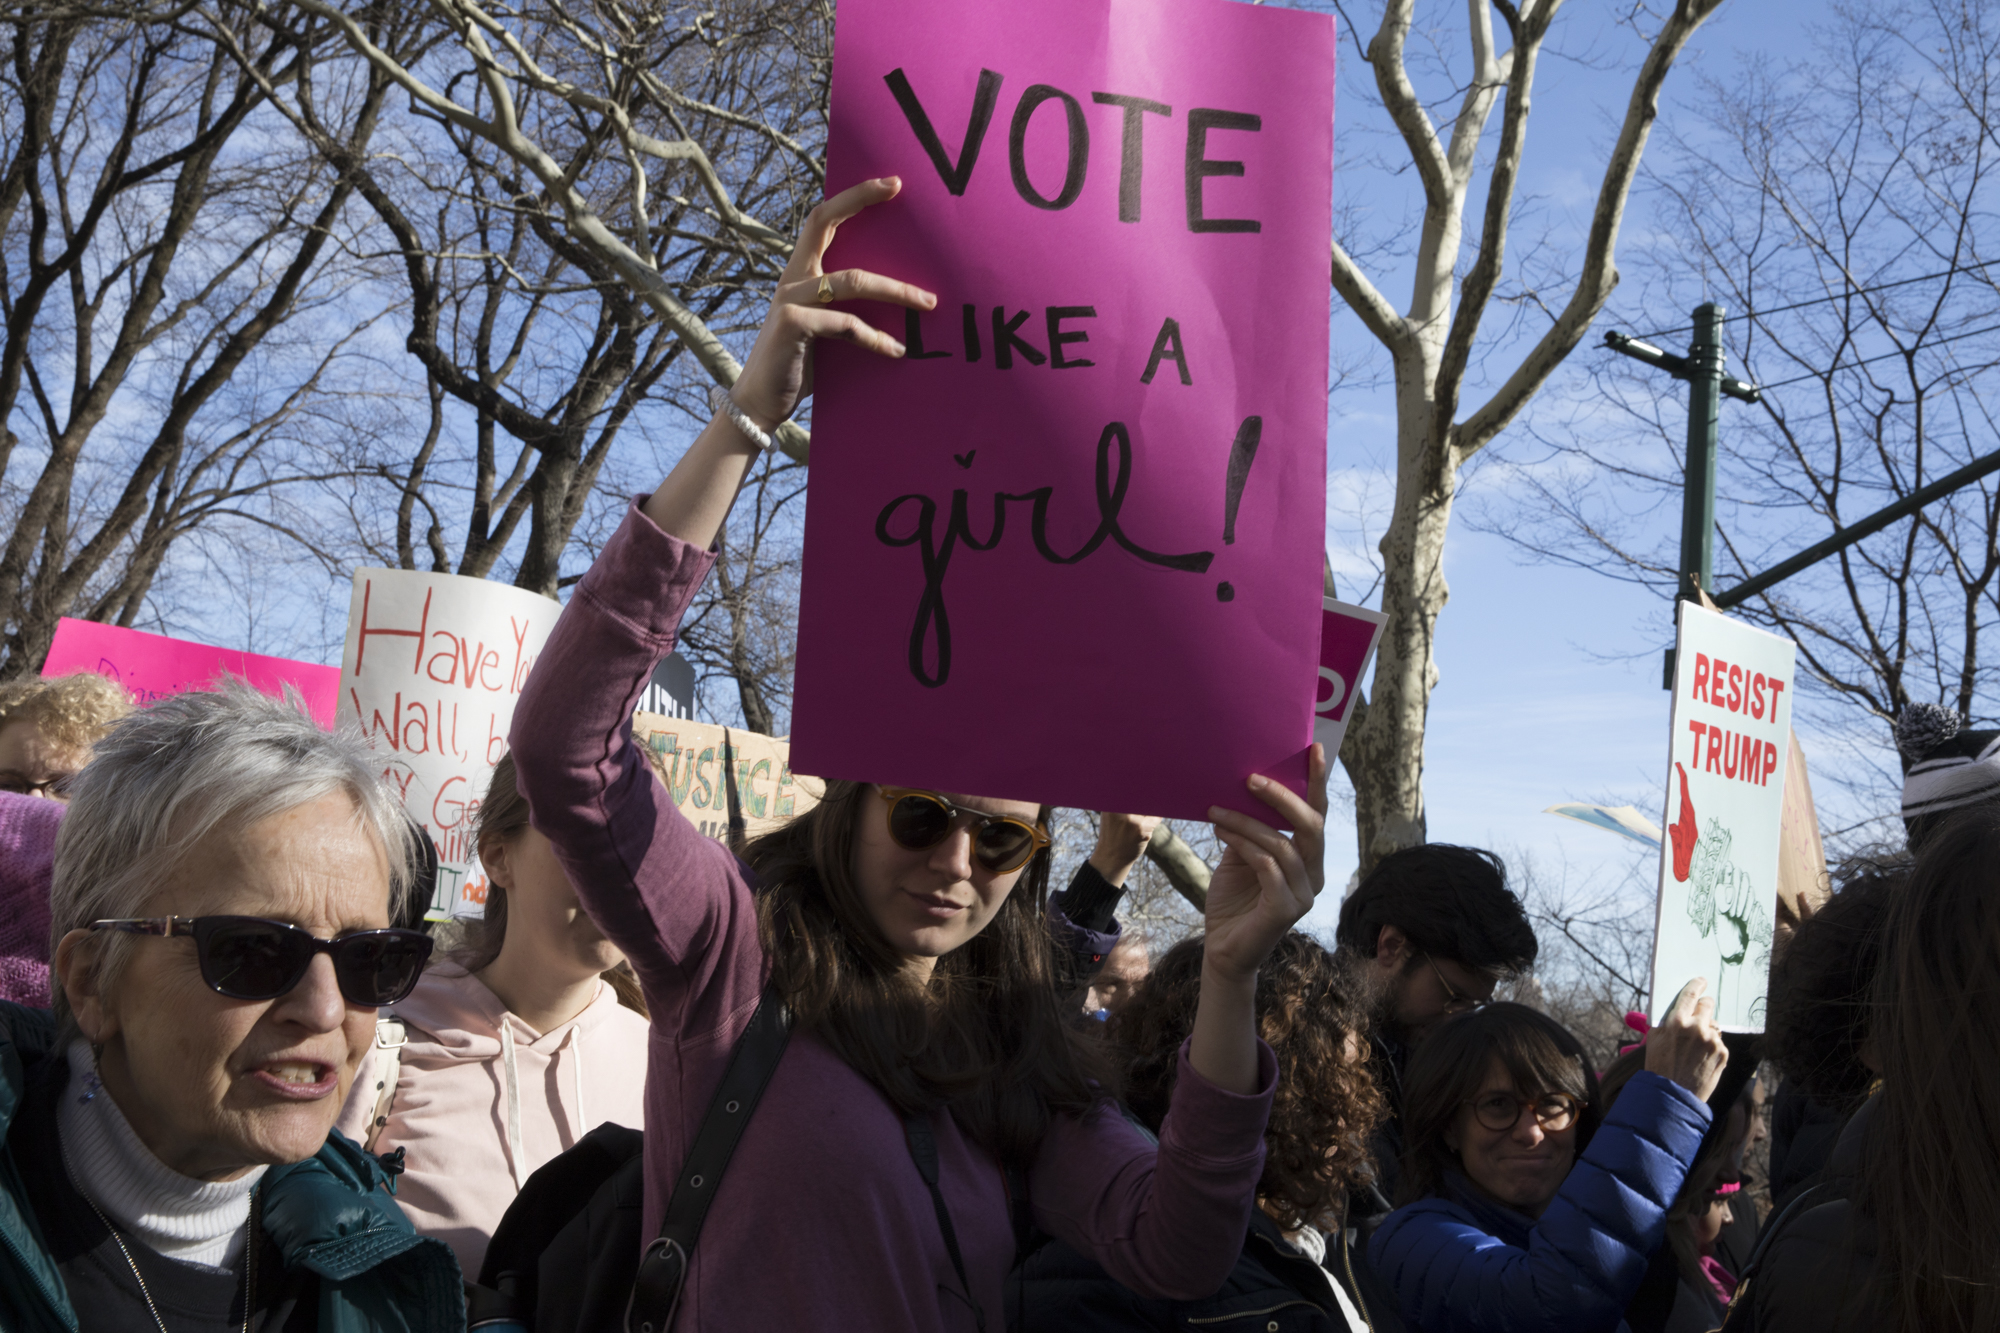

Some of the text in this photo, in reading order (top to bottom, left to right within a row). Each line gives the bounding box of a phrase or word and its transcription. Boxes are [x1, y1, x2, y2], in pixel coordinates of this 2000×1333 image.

[883, 67, 1262, 234] VOTE
[904, 304, 1193, 386] LIKE A
[874, 415, 1263, 689] girl!
[355, 579, 538, 695] Have Yo
[350, 687, 468, 764] Wall,
[1692, 652, 1785, 724] RESIST
[1689, 719, 1778, 787] TRUMP
[432, 776, 483, 830] Ge
